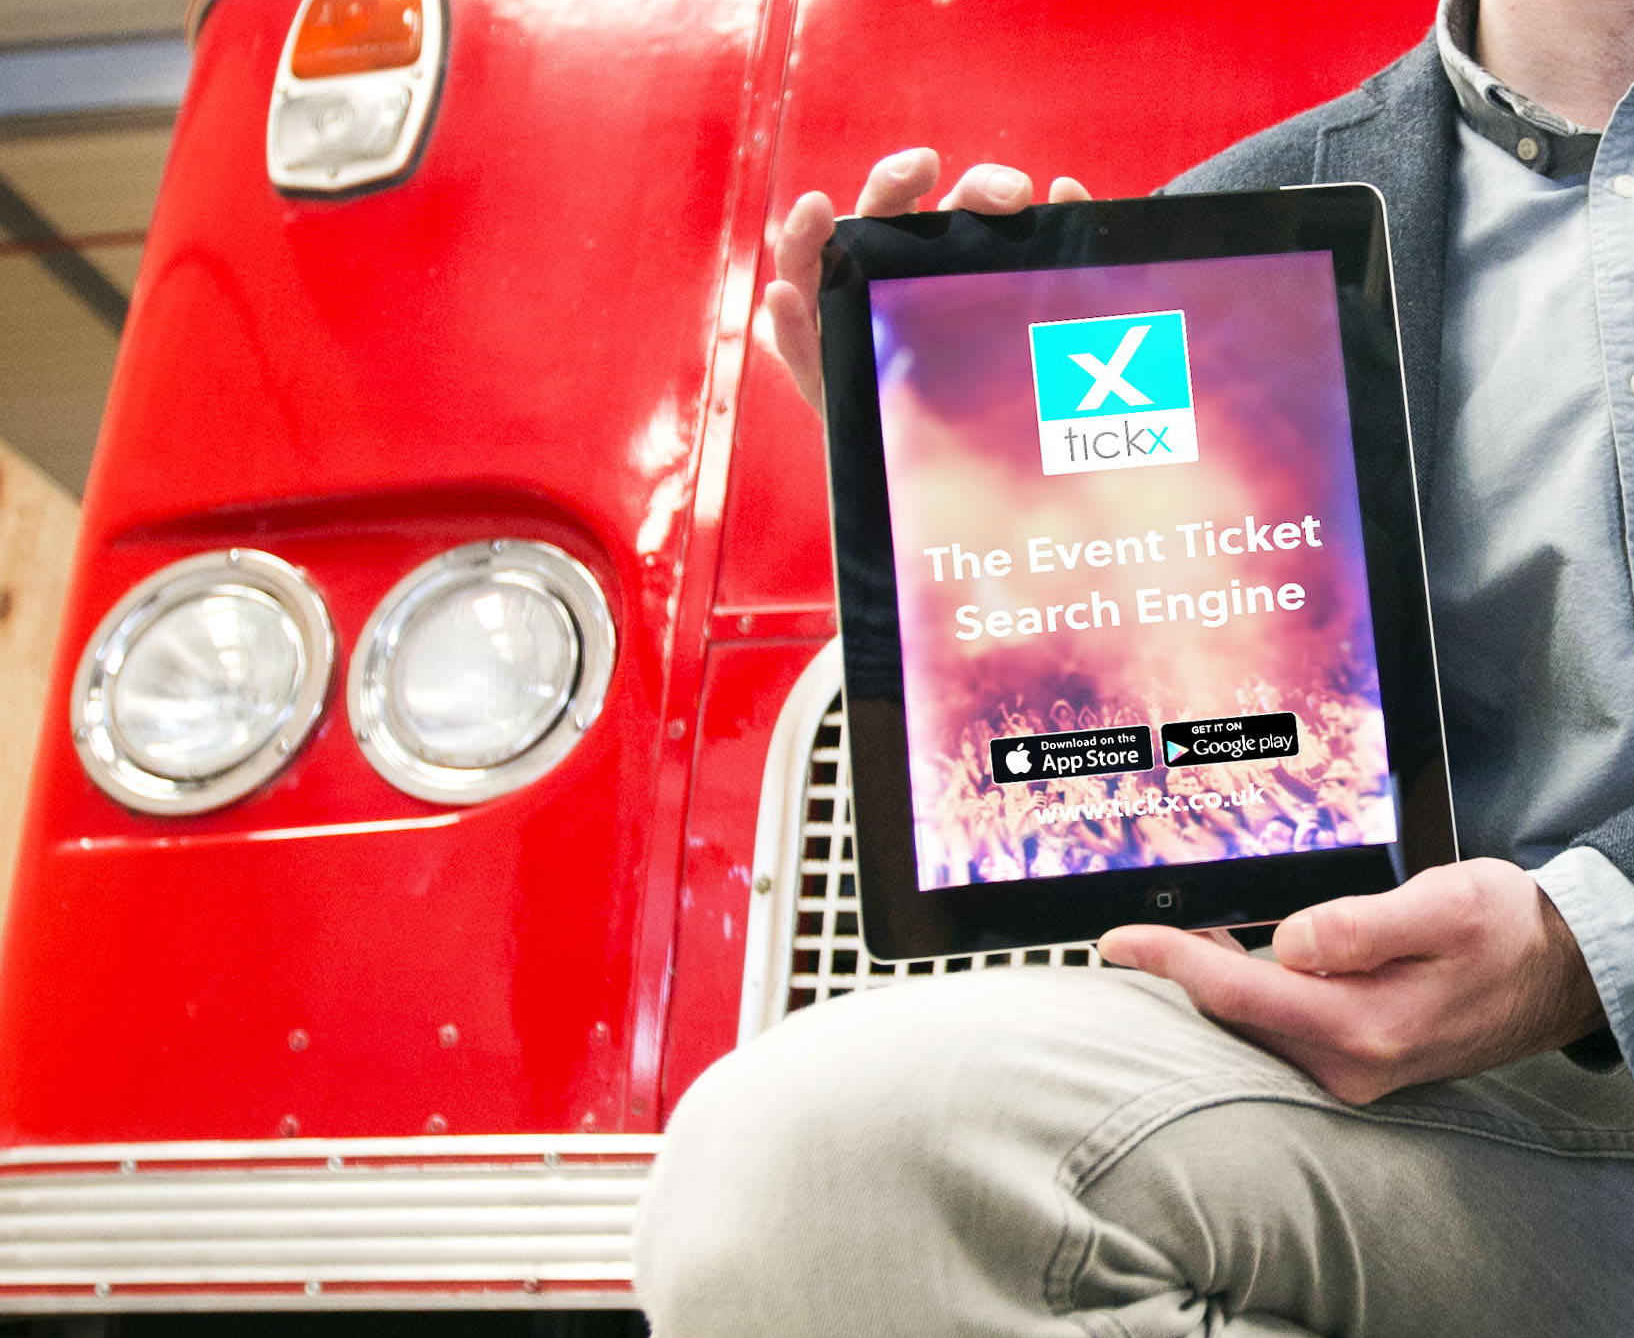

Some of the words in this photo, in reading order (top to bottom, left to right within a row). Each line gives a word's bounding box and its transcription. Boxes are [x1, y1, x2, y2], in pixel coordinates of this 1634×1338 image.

[1064, 419, 1173, 462] tickx
[923, 542, 1013, 582] The
[1026, 529, 1166, 574] Event
[1175, 514, 1323, 559] Ticket
[954, 590, 1121, 641] Search
[1135, 579, 1307, 628] Engine
[1040, 735, 1097, 751] Download
[1099, 736, 1115, 746] on
[1117, 733, 1137, 744] the
[1191, 724, 1212, 735] GET
[1213, 723, 1224, 733] IT
[1225, 721, 1243, 732] ON
[1042, 753, 1083, 775] App
[1086, 749, 1139, 768] Store
[1192, 734, 1257, 758] Google
[1259, 733, 1293, 753] play
[1034, 782, 1267, 826] www.tickx.co.uk
